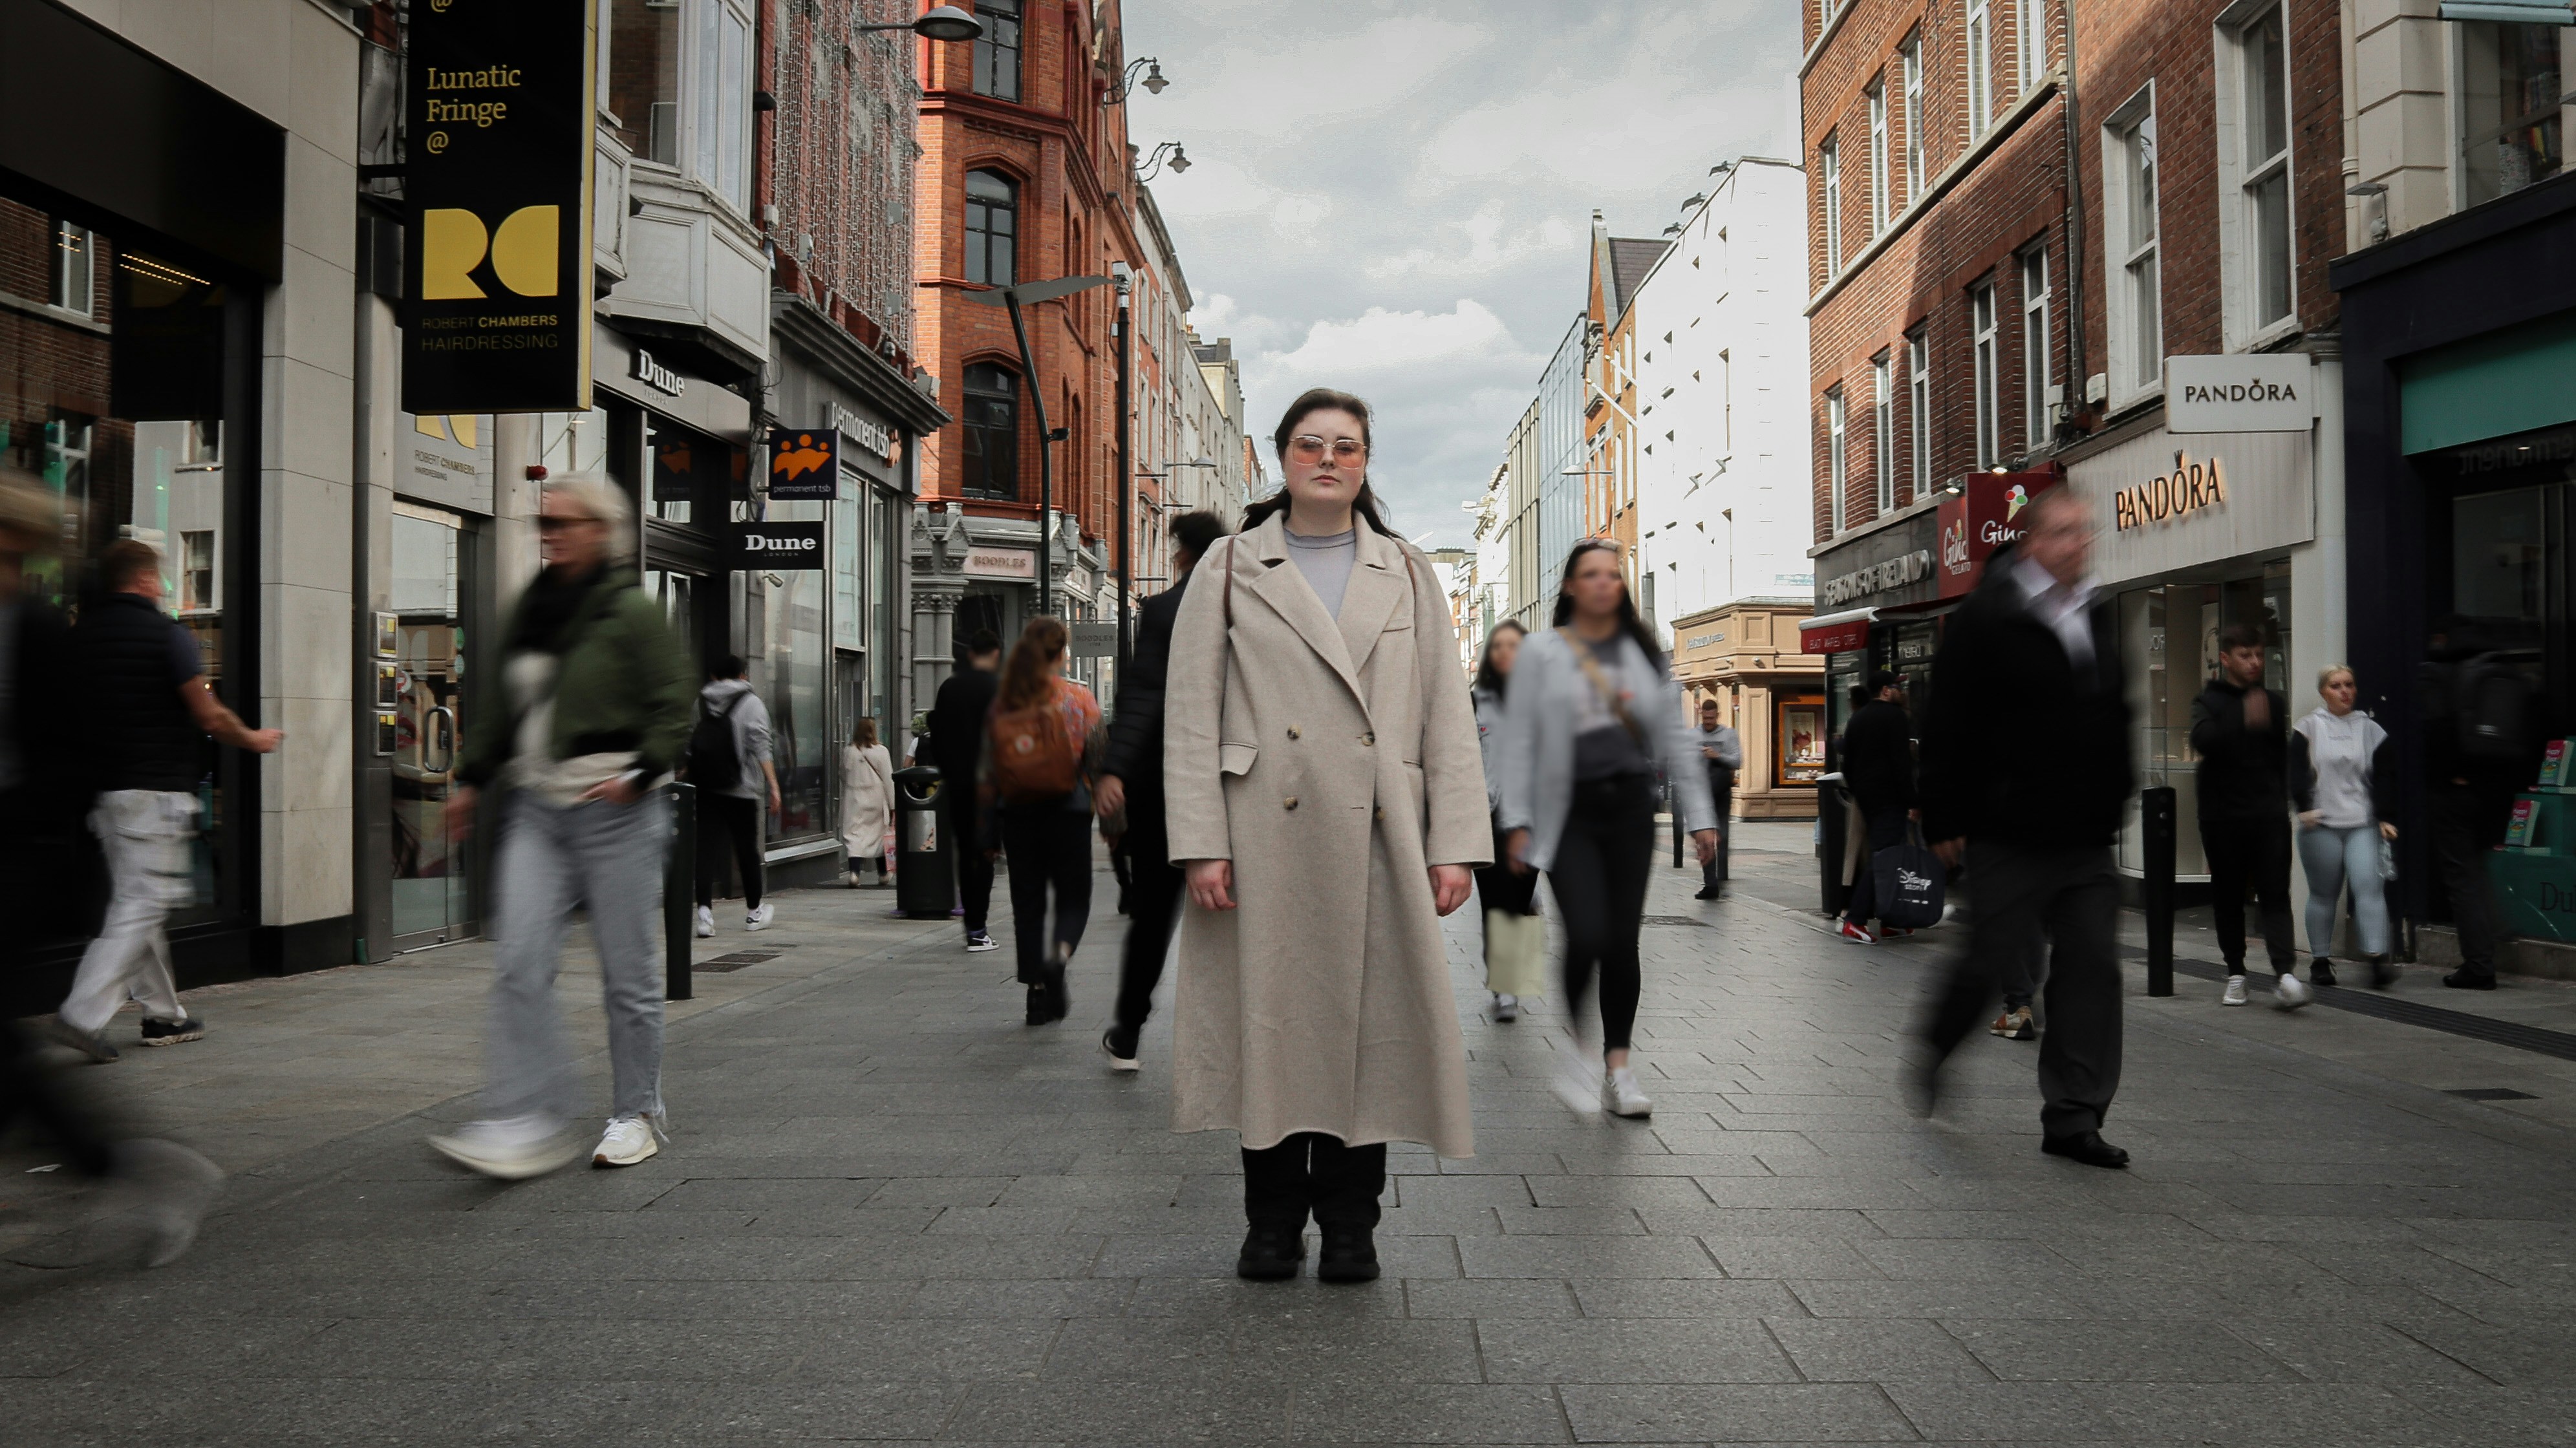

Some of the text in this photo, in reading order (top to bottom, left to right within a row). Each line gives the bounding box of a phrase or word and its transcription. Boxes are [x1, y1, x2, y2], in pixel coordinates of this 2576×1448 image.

[427, 65, 521, 90] Lunatic
[426, 99, 508, 128] Fringe
[426, 131, 449, 154] @
[422, 314, 559, 330] ROBERT CHAMBERS
[422, 334, 559, 352] HAIRDRESSING
[638, 348, 685, 398] Dune
[2185, 378, 2297, 403] PANDORA
[832, 401, 890, 459] permanent tsb
[773, 484, 832, 494] permanent tsb
[2116, 450, 2223, 532] PANDORA
[745, 535, 817, 551] Dune
[973, 555, 1026, 569] BOODLES
[2538, 880, 2576, 913] Du
